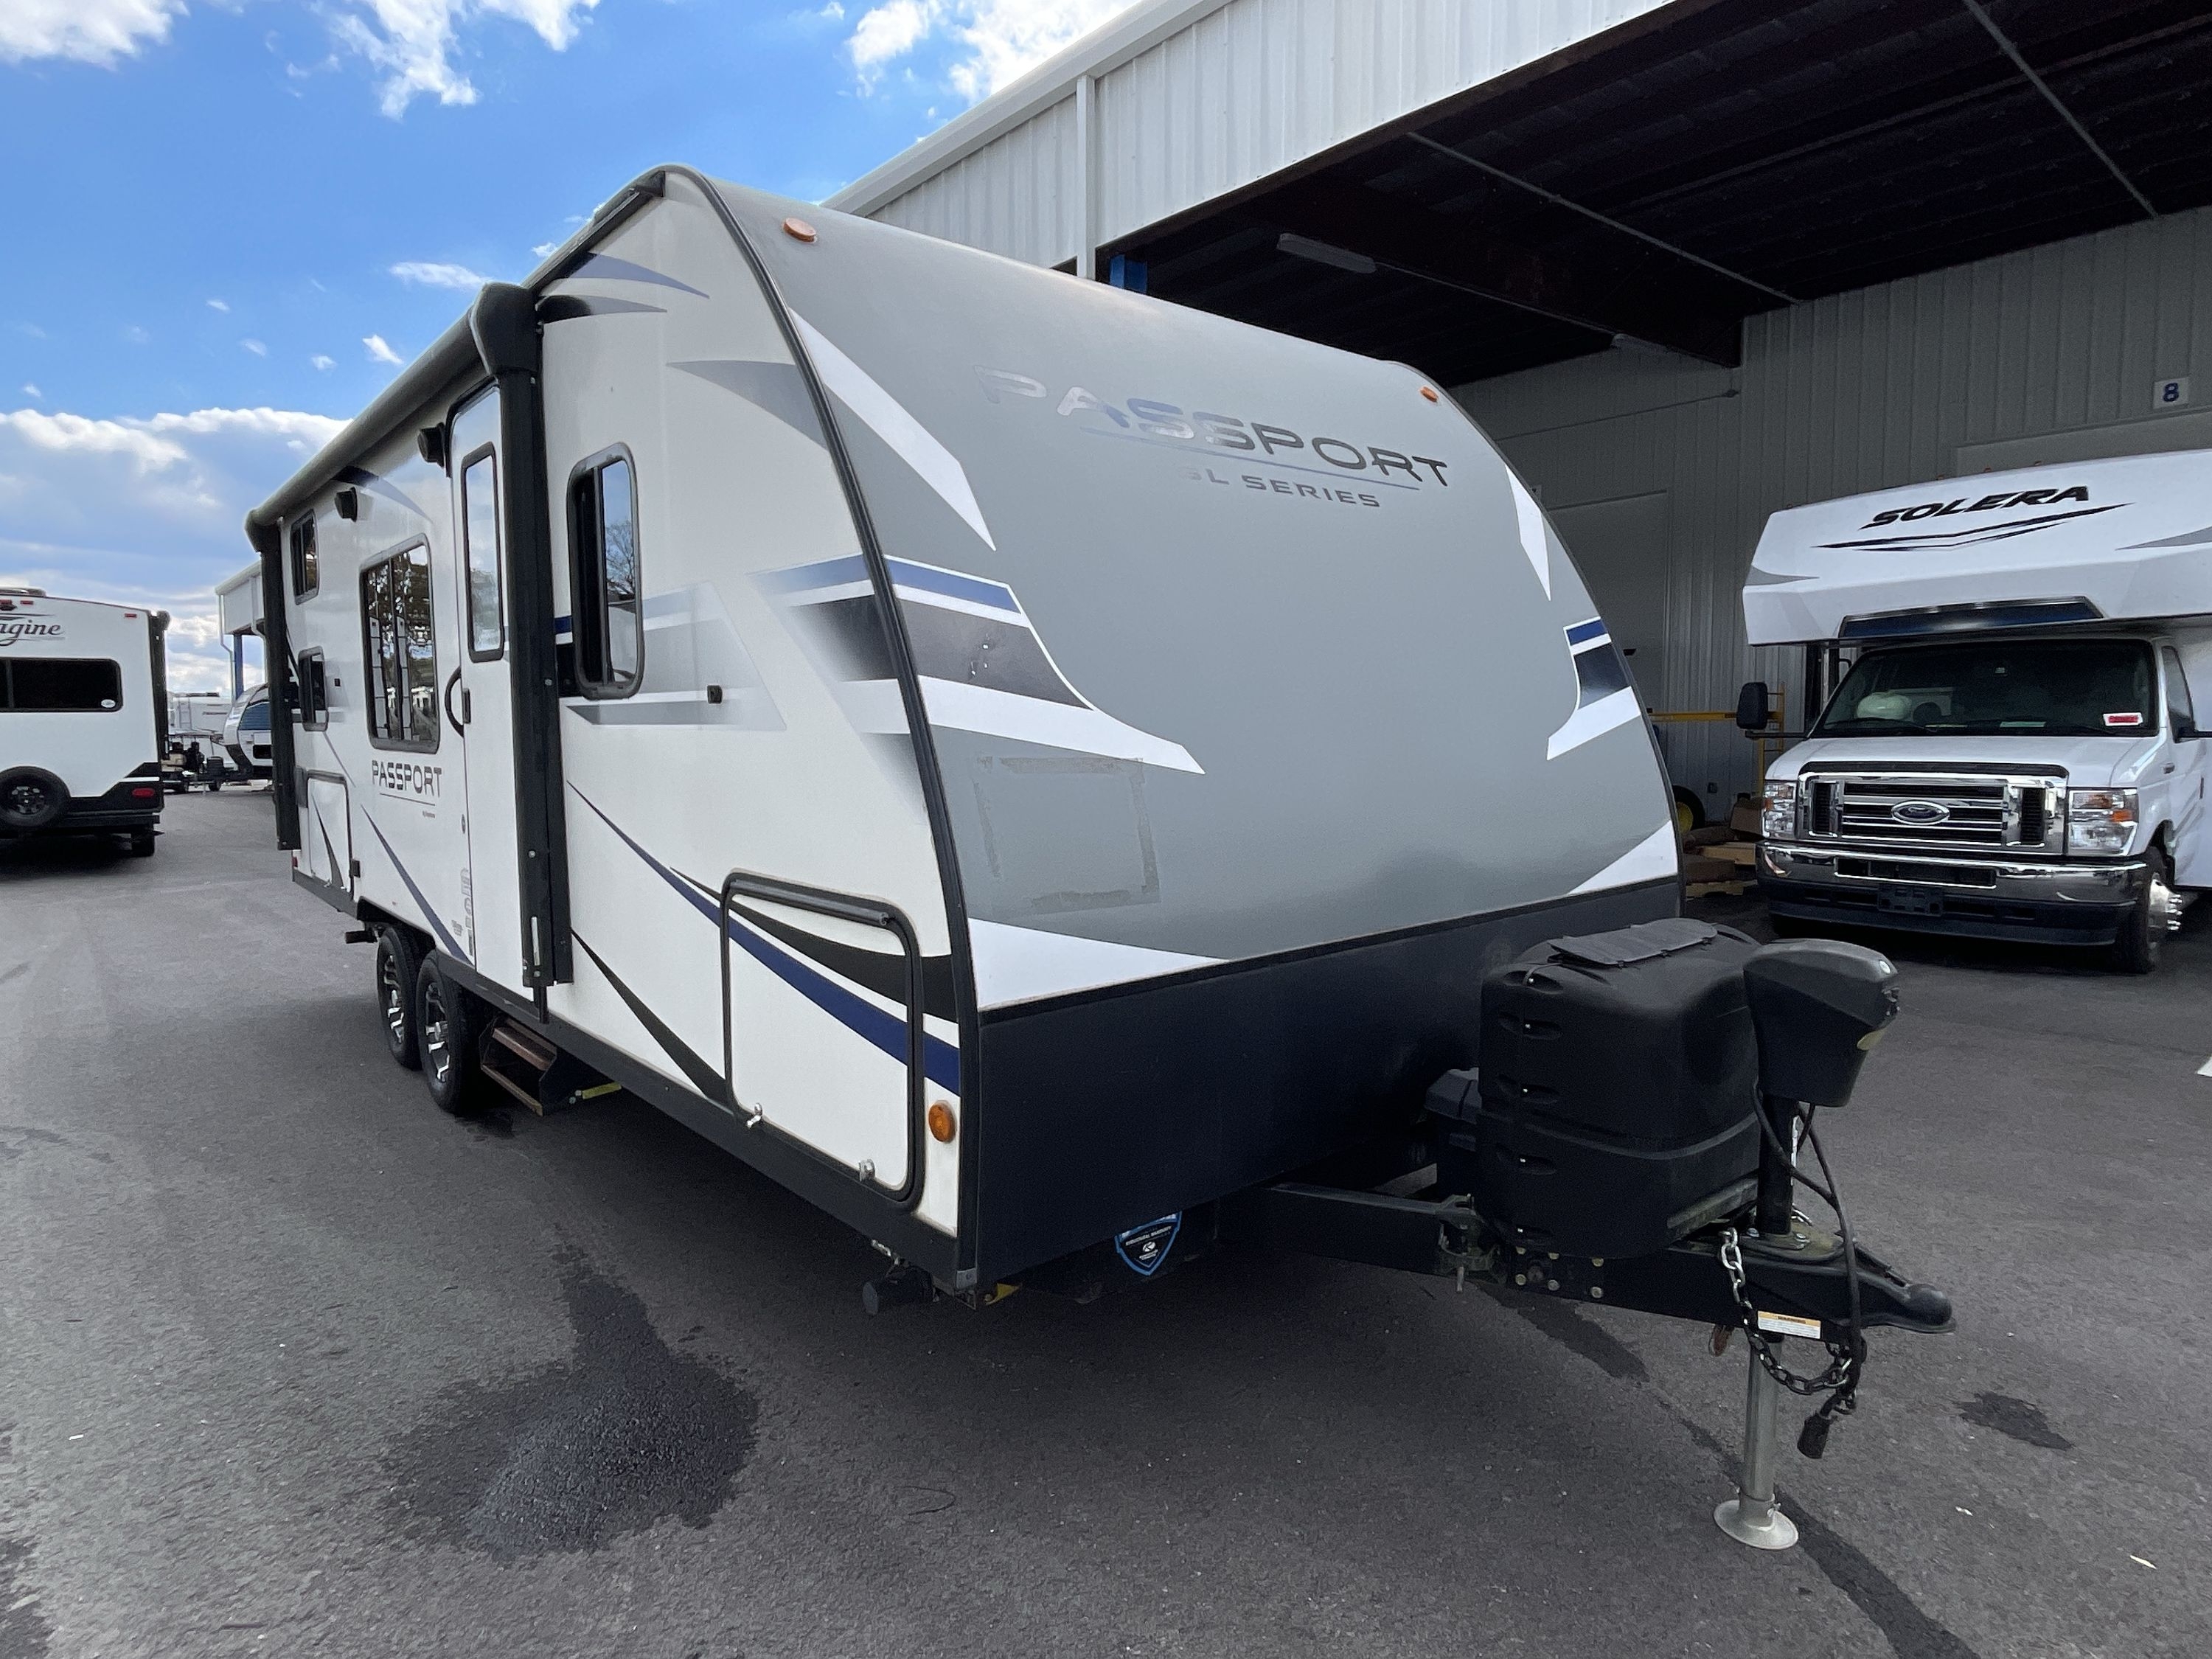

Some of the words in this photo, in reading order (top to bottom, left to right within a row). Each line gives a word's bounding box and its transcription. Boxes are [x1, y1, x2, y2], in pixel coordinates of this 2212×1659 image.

[2163, 382, 2180, 403] 8
[973, 365, 1447, 487] PASSPORT
[1241, 474, 1380, 507] SERIES
[1858, 485, 2089, 530] SOLERA
[372, 759, 442, 798] PASSPORT
